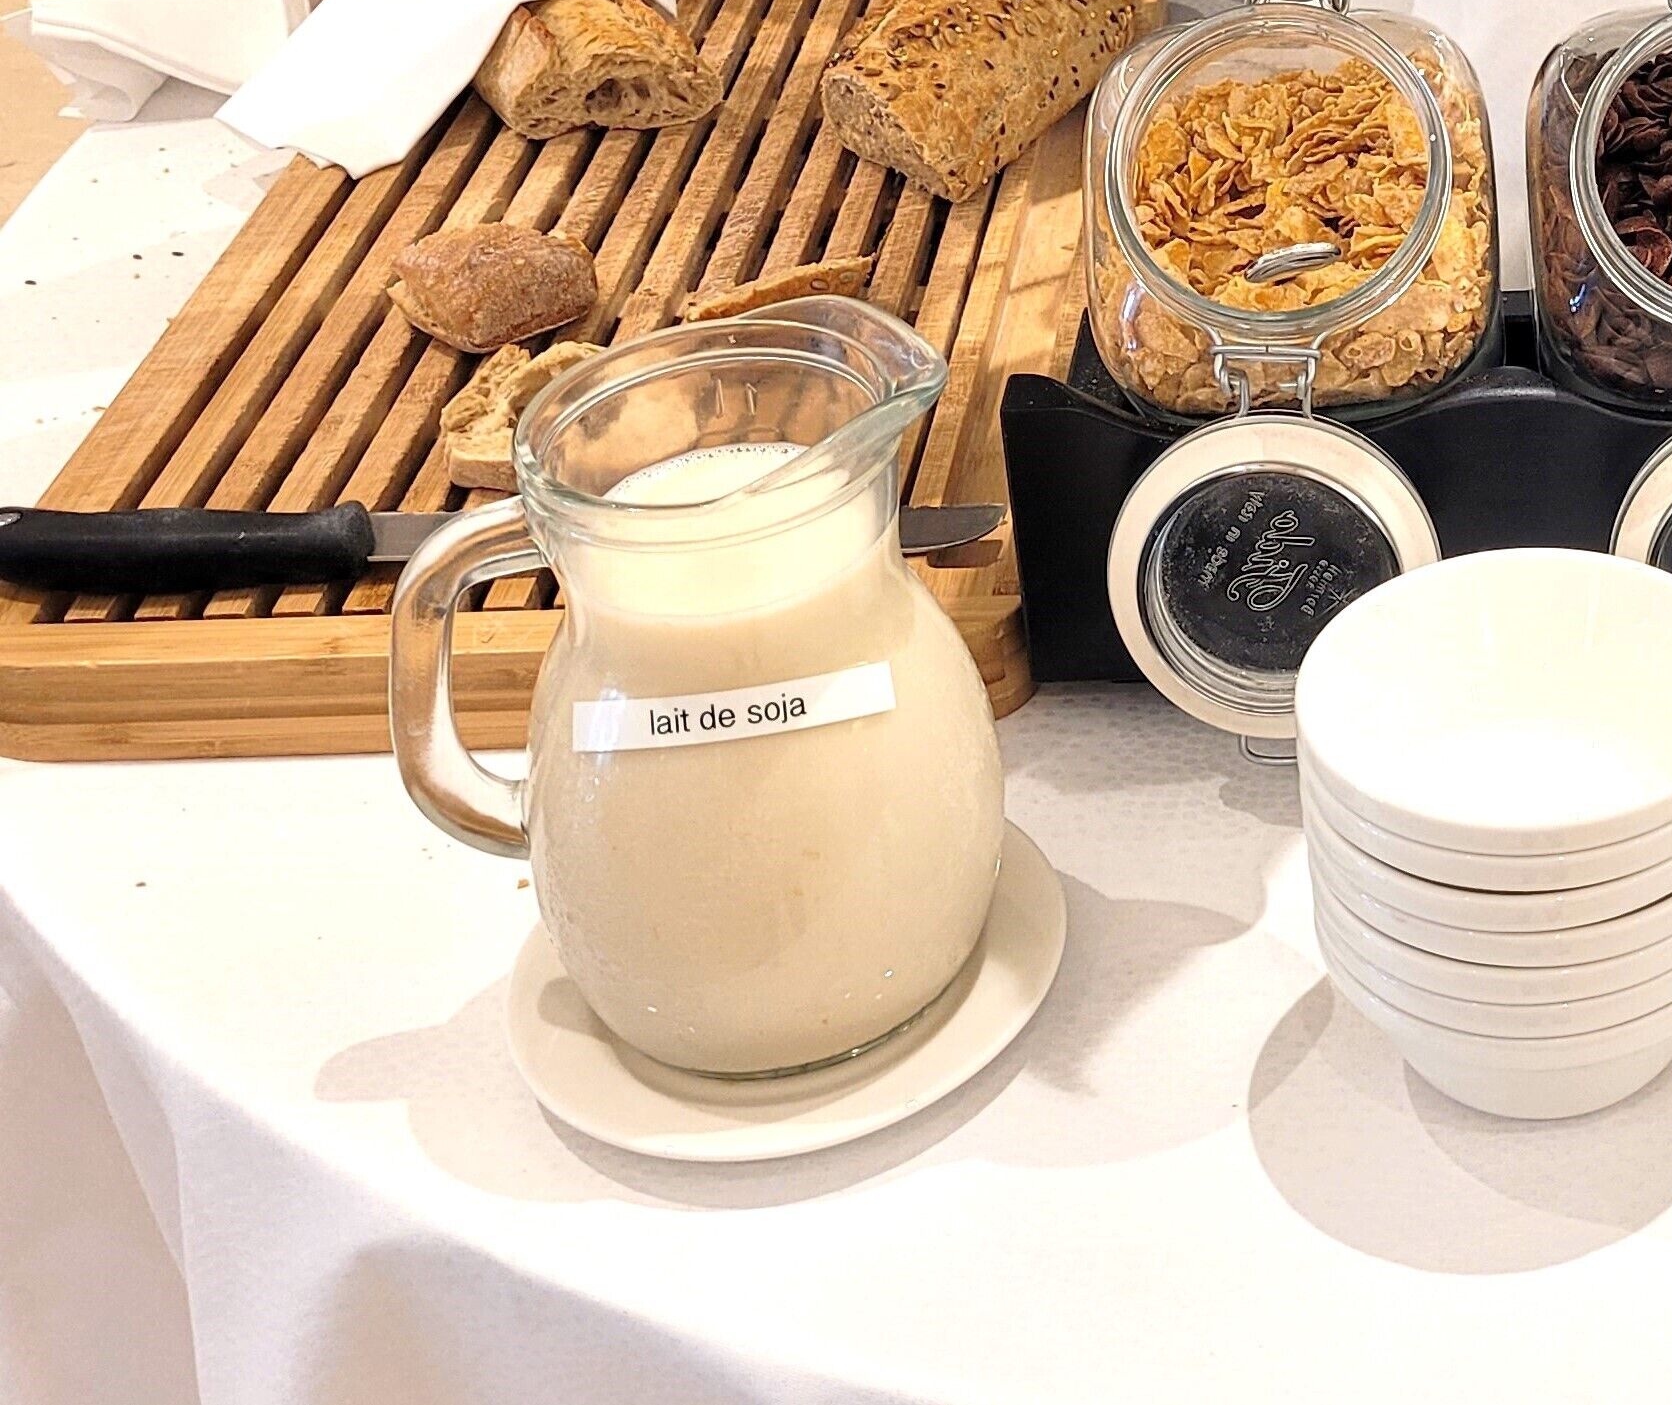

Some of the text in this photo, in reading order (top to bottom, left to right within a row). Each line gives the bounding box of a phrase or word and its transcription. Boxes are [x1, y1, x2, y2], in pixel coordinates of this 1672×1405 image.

[649, 692, 808, 736] lait de soja
